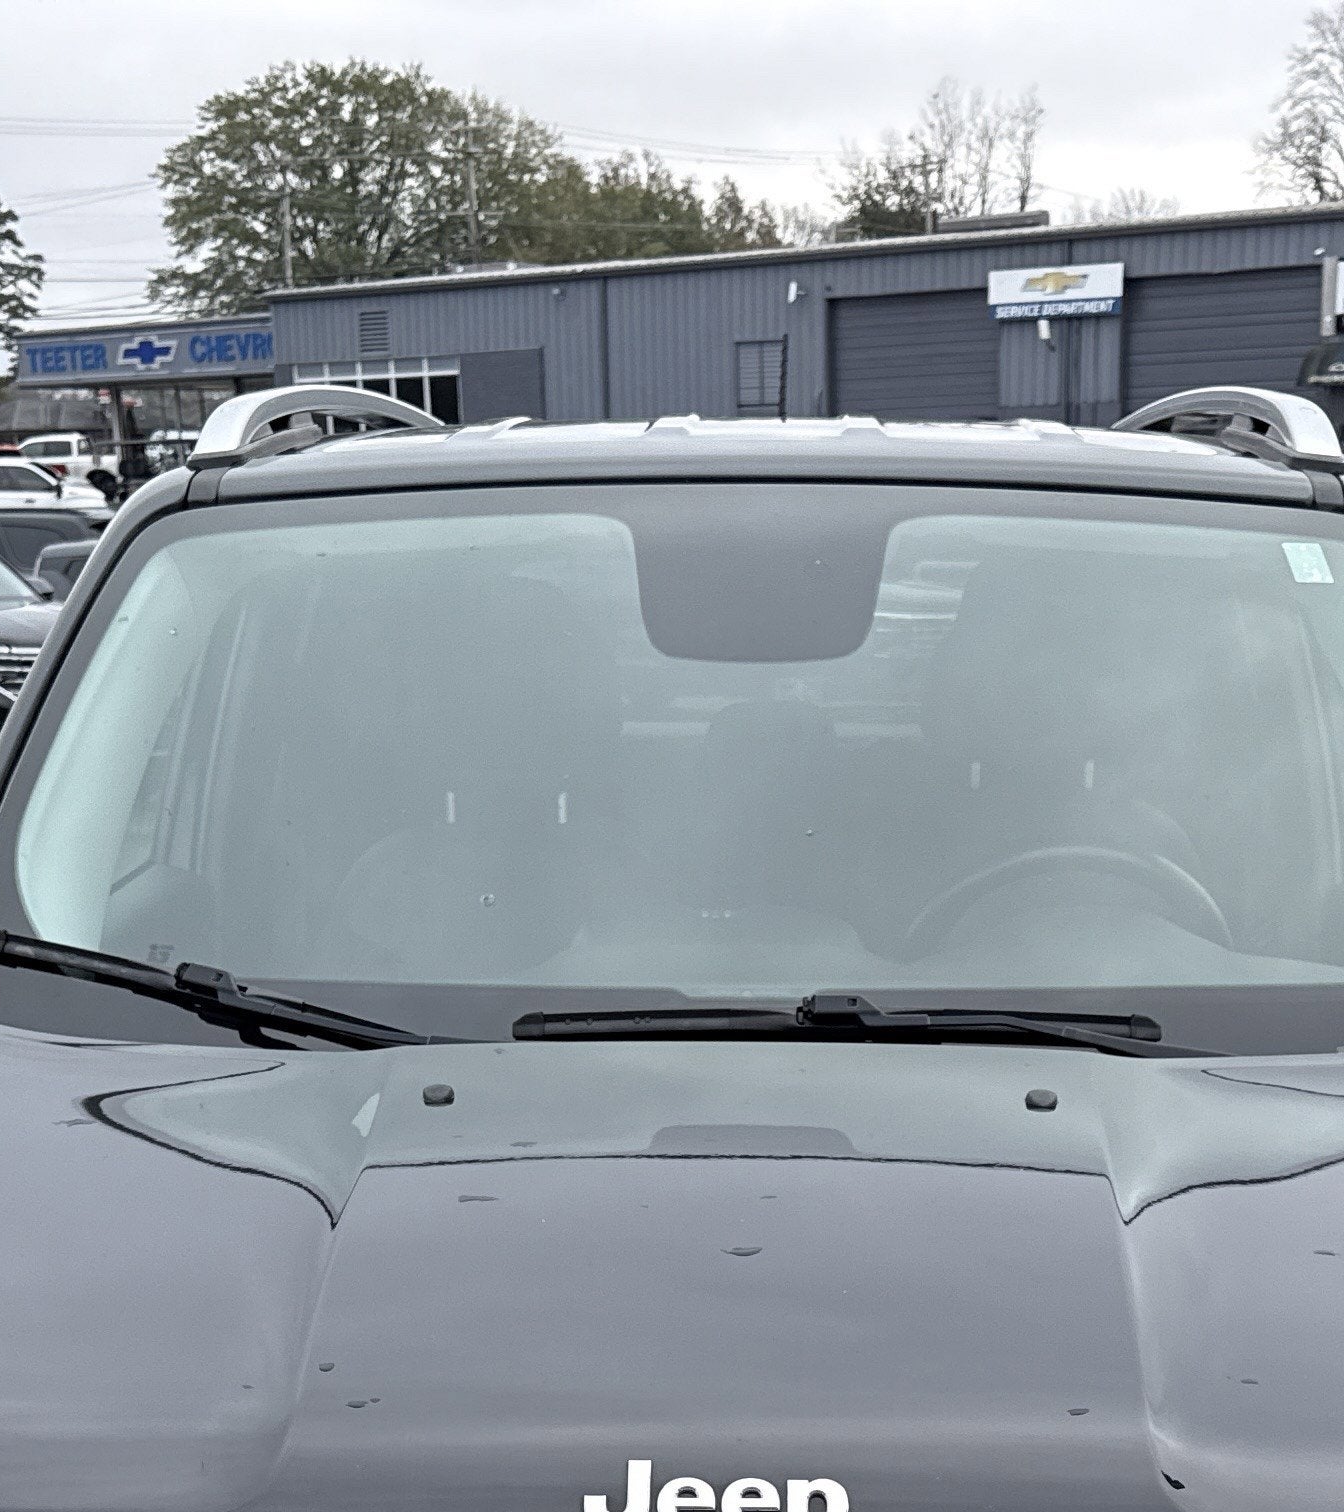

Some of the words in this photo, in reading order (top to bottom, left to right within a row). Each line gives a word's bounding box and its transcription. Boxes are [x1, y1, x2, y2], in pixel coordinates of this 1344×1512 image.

[994, 304, 1042, 319] SERVICE
[1043, 299, 1116, 317] DEPARTMENT
[25, 343, 107, 373] TEETER
